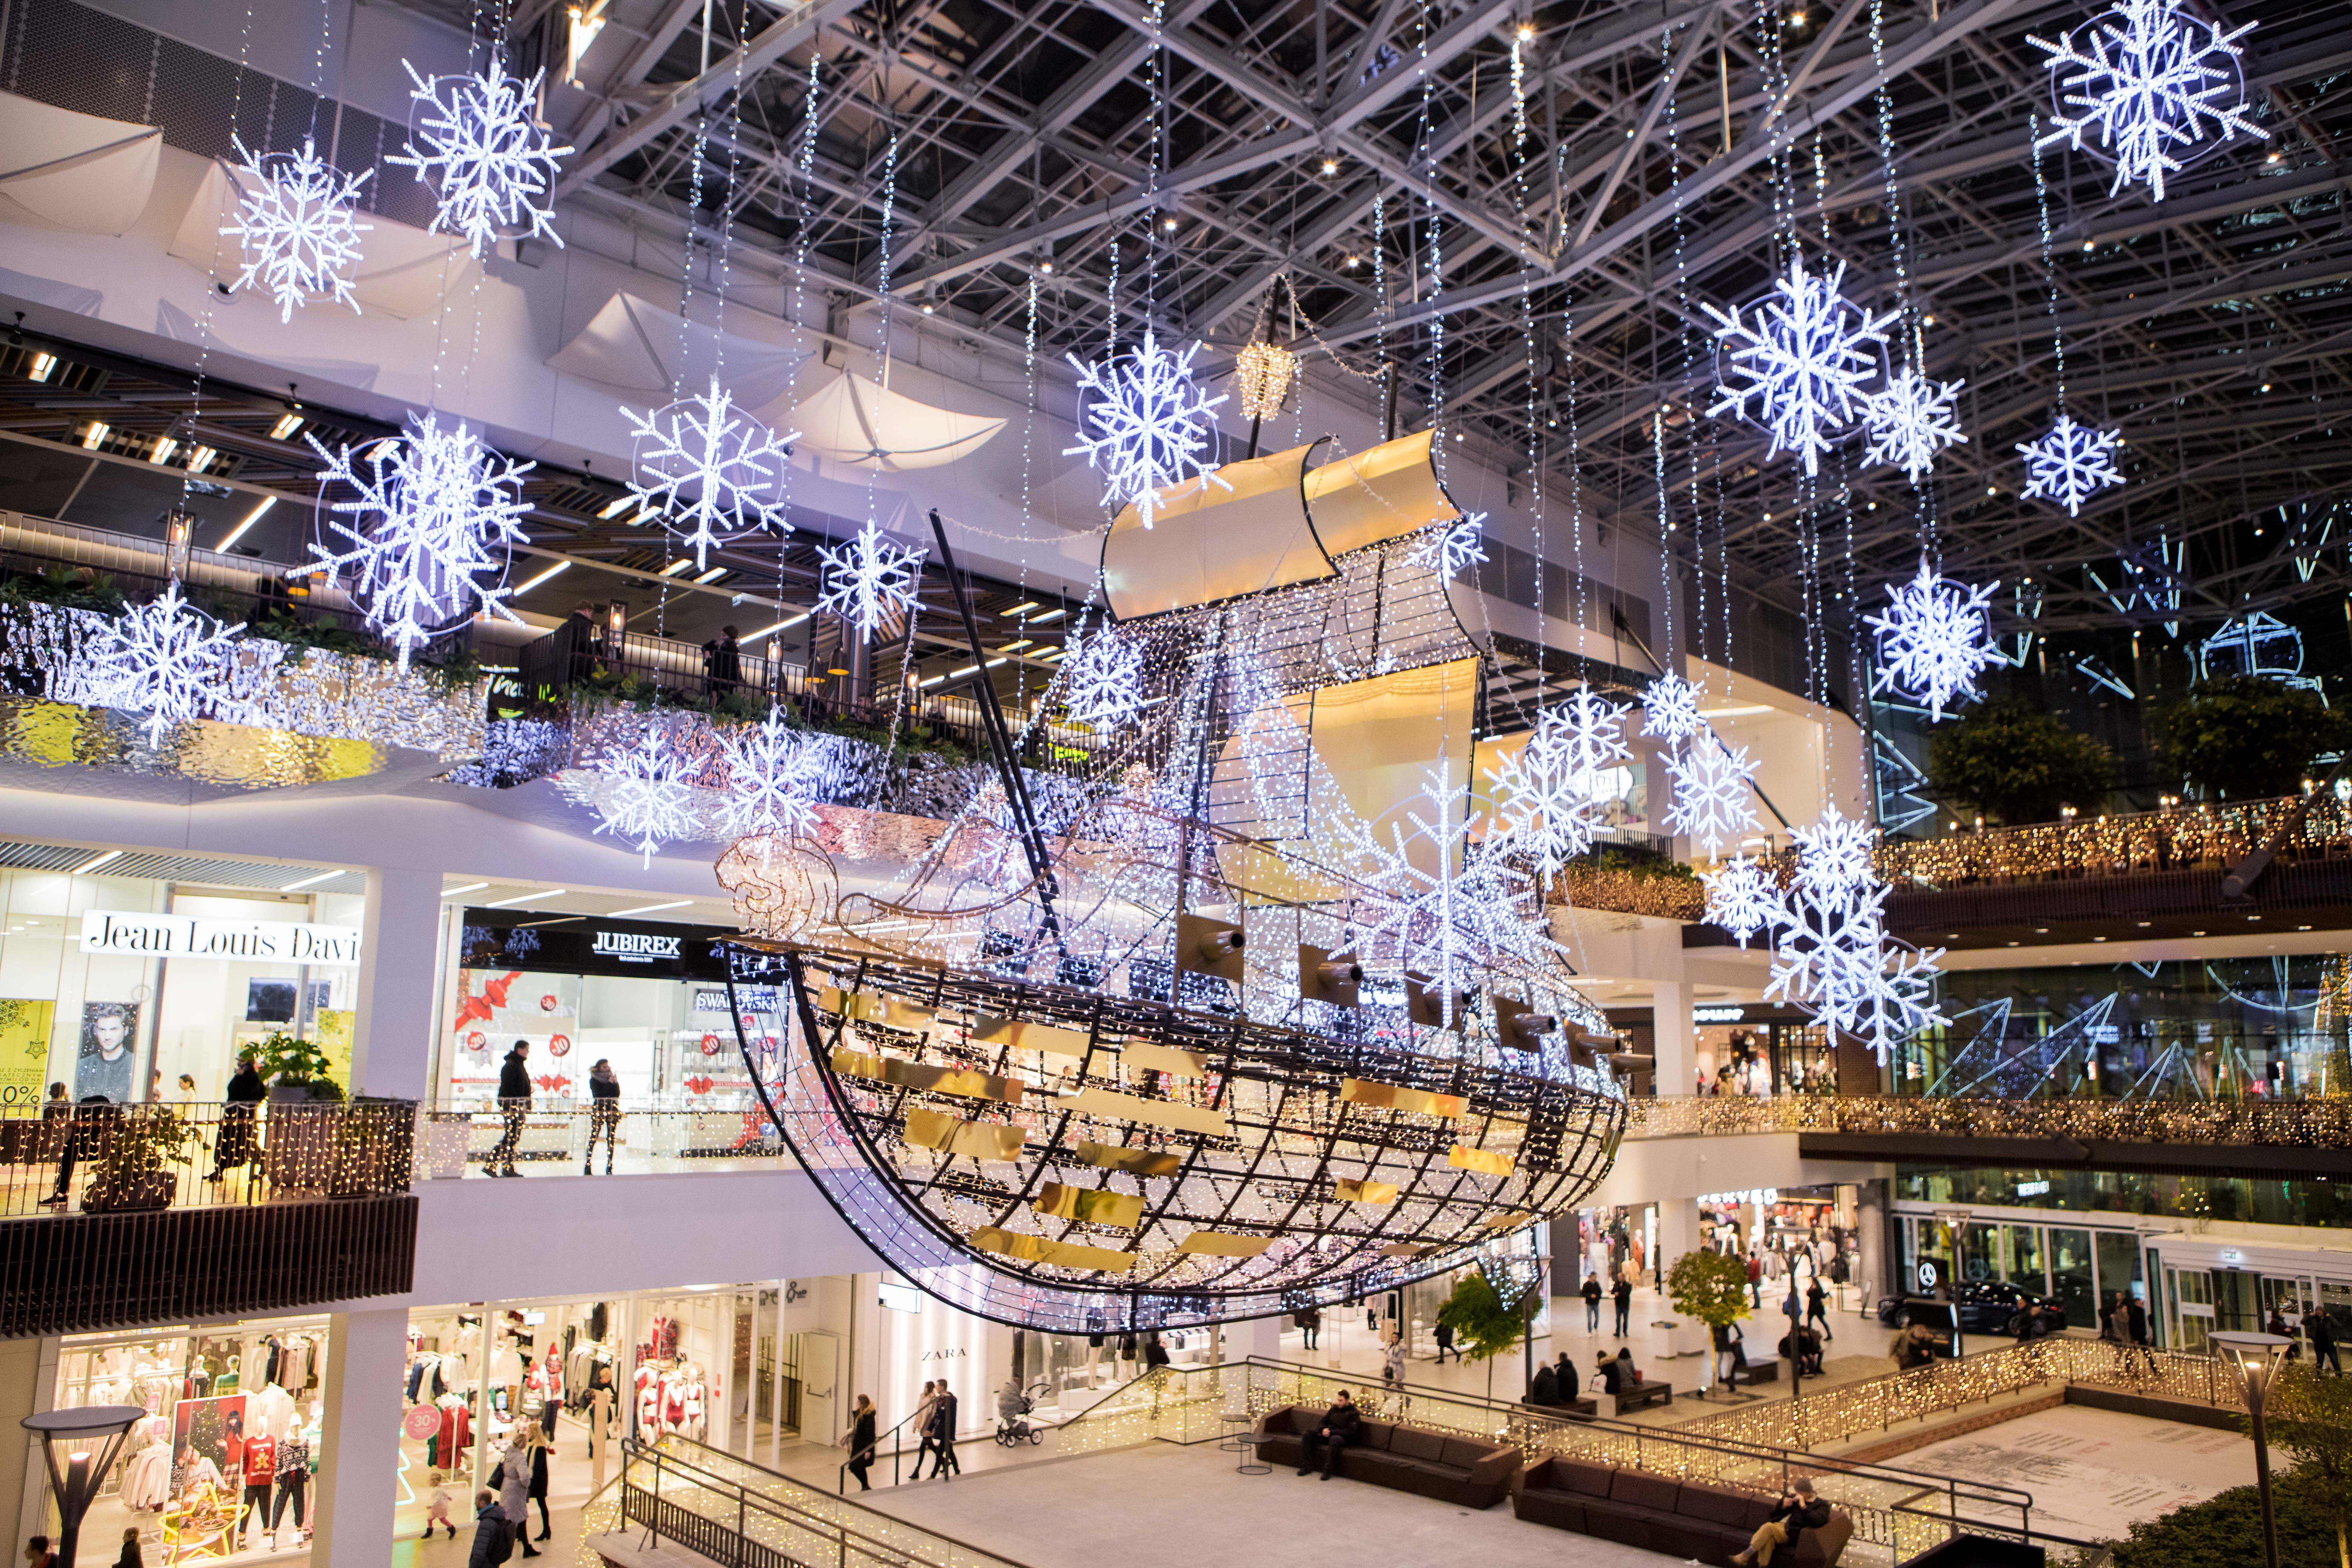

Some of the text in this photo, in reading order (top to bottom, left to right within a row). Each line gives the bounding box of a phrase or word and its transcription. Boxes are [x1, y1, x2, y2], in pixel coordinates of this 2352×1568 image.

[90, 915, 361, 961] Jean Louis Davi
[591, 932, 681, 955] JUBIREX
[0, 1086, 39, 1103] 0%
[922, 1347, 967, 1361] ZARA
